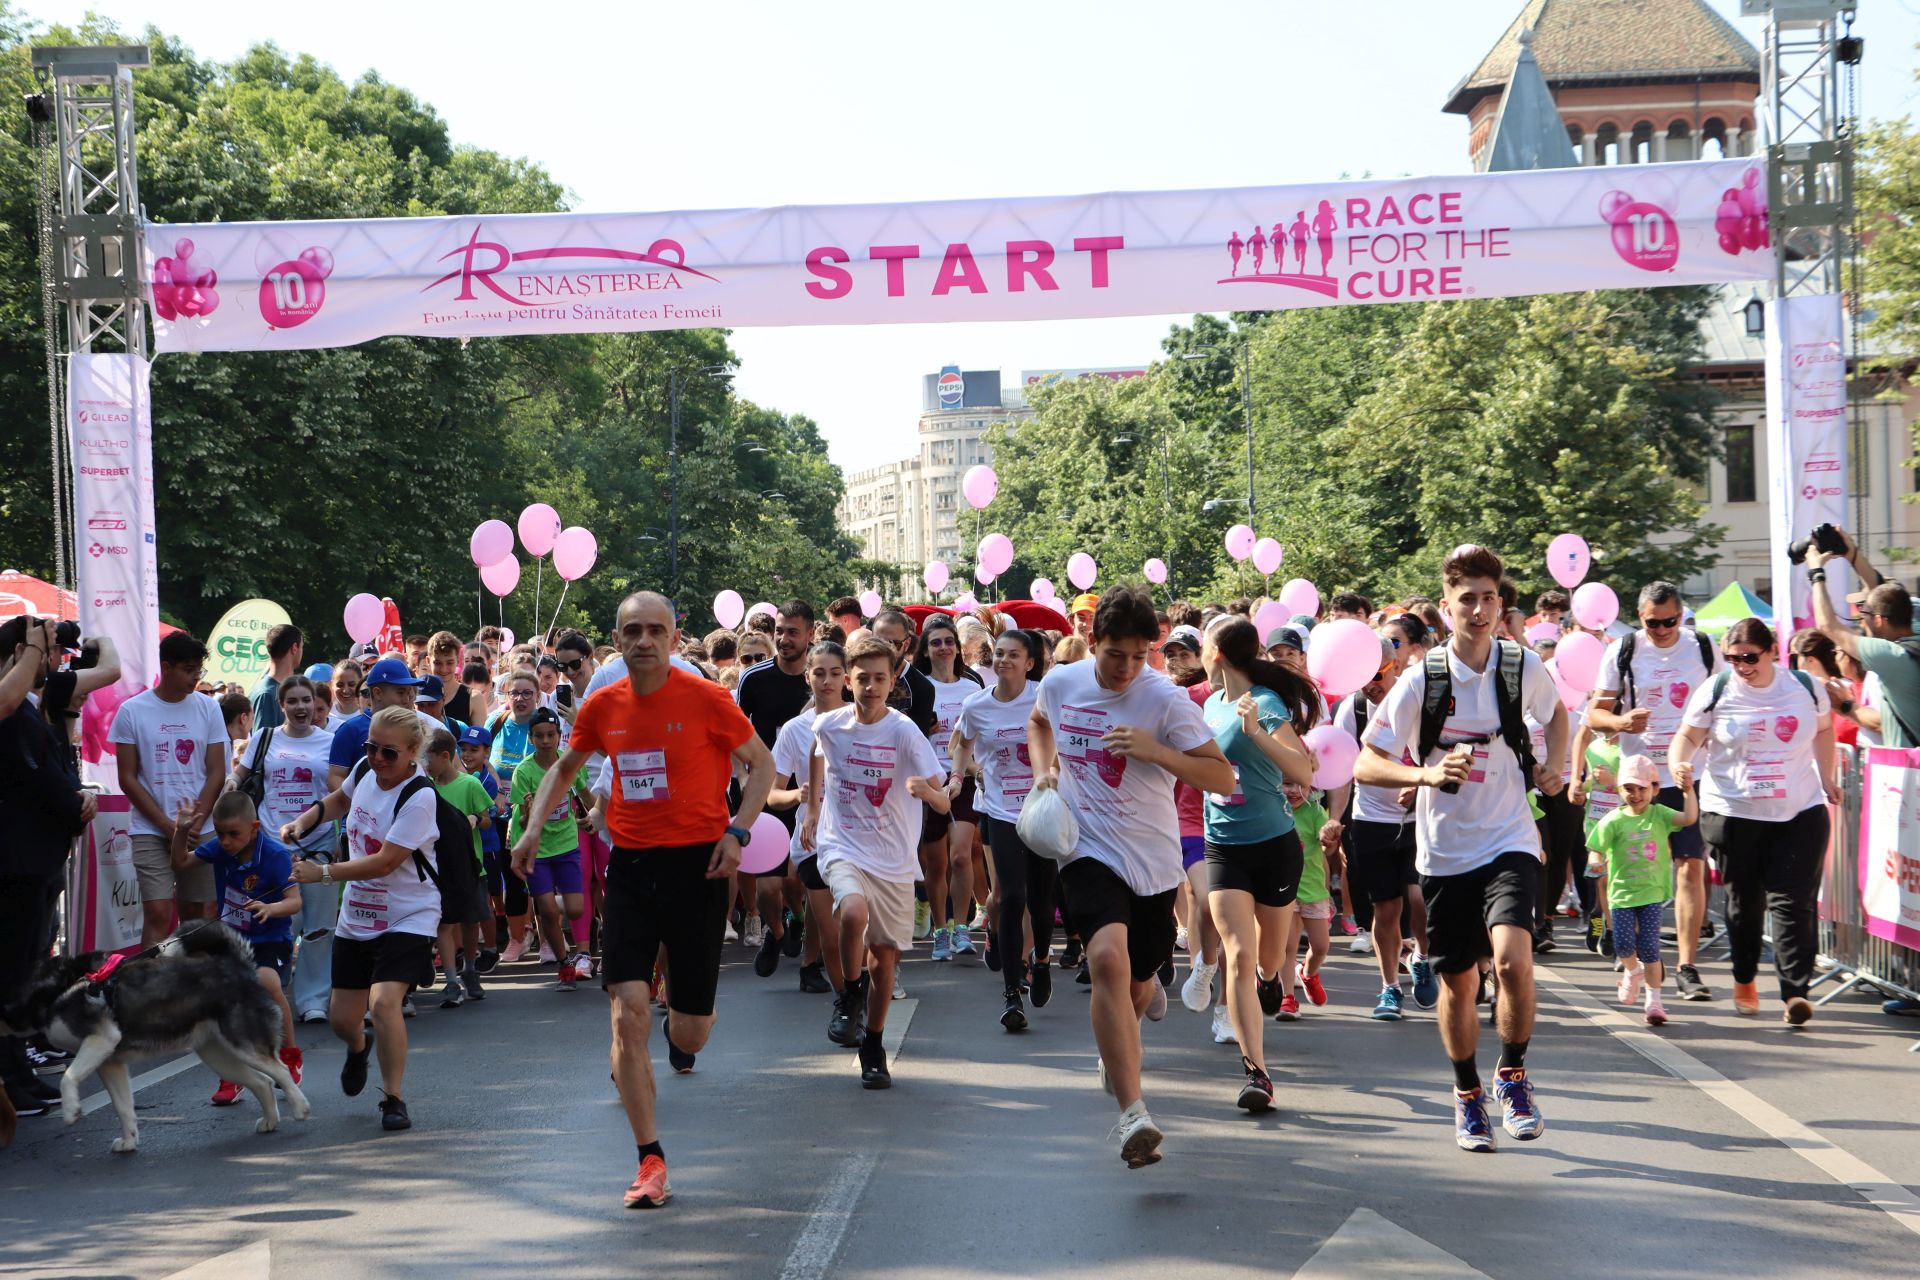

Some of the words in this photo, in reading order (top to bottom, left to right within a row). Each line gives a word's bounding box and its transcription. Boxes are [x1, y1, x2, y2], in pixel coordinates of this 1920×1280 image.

[1345, 191, 1463, 228] RACE
[1627, 212, 1666, 253] 10
[1347, 231, 1427, 265] FOR
[1435, 227, 1511, 260] THE
[804, 235, 1125, 300] START
[1346, 266, 1463, 300] CURE
[267, 271, 306, 309] 10
[507, 306, 567, 322] pentru
[572, 303, 658, 320] Sănătatea
[663, 303, 722, 319] Femeii
[938, 384, 962, 392] PEPSI
[91, 413, 129, 422] GILEAD
[79, 439, 129, 449] KULTHO
[80, 466, 130, 476] SUPERBET
[107, 546, 128, 554] MSD
[105, 598, 127, 606] profi
[227, 619, 248, 628] CEC
[217, 635, 270, 660] CEC
[1069, 736, 1089, 747] 341
[863, 769, 882, 778] 433
[629, 777, 655, 789] 1647
[1753, 781, 1776, 790] 2536
[284, 797, 304, 805] 1060
[355, 909, 377, 919] 1750
